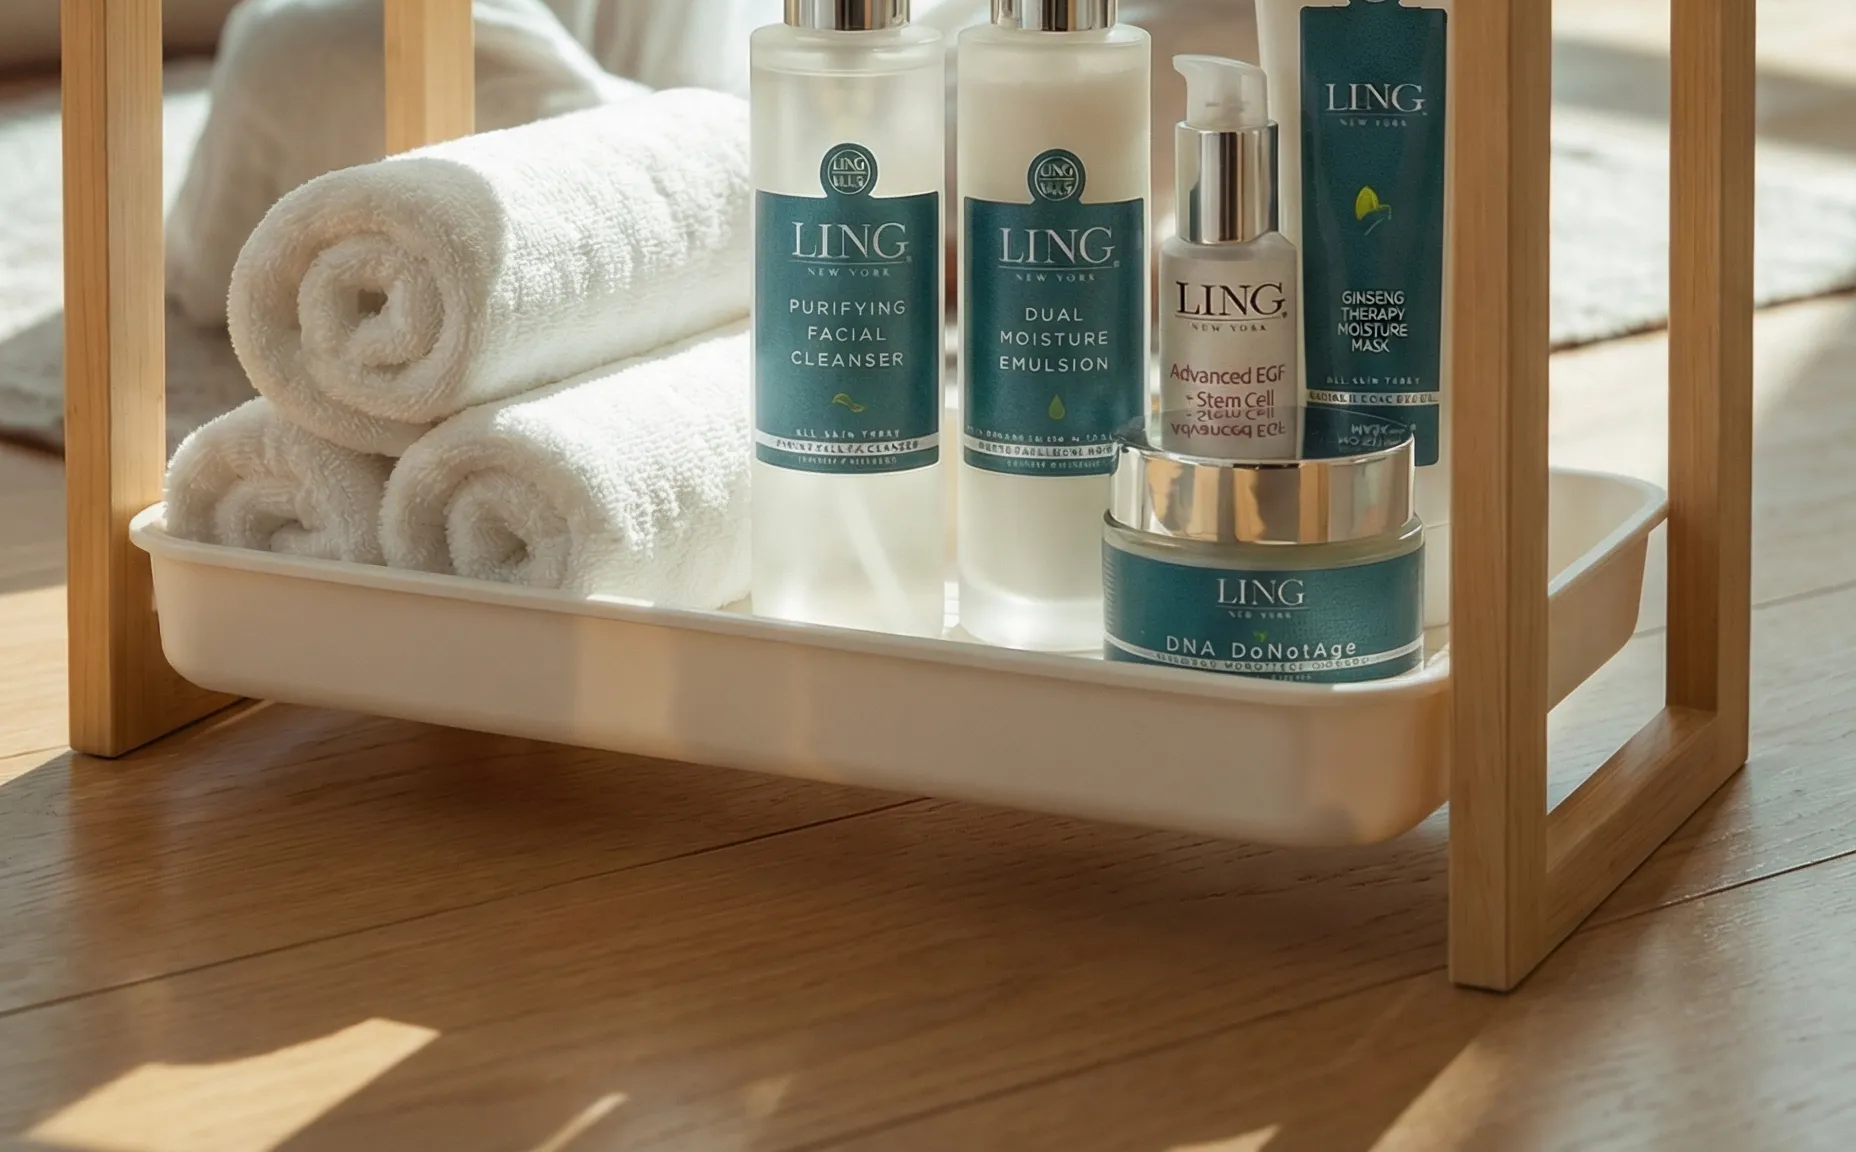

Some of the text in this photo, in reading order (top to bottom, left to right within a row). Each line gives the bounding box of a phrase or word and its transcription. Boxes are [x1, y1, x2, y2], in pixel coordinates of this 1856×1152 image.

[1325, 83, 1426, 112] LING
[791, 221, 909, 259] LING
[999, 226, 1115, 264] LING
[807, 267, 840, 277] NEW
[1016, 273, 1095, 282] NEW YORK
[1175, 281, 1287, 316] LING
[1341, 291, 1405, 305] GINSENG
[789, 298, 906, 316] PURIFYING
[1025, 307, 1083, 322] DUAL
[1341, 307, 1405, 321] THERAPY
[808, 326, 886, 342] FACIAL
[1338, 323, 1408, 338] MOISTURE
[1000, 331, 1109, 347] MOISTURE
[1351, 339, 1390, 353] MASK
[791, 351, 904, 367] CLEANSER
[1000, 356, 1109, 372] EMULSION
[1170, 363, 1287, 385] Advanced EGF
[1197, 391, 1241, 409] Stem
[1245, 390, 1275, 407] Cell
[1216, 578, 1306, 606] LING
[1166, 635, 1357, 660] DNA DoNotAge
